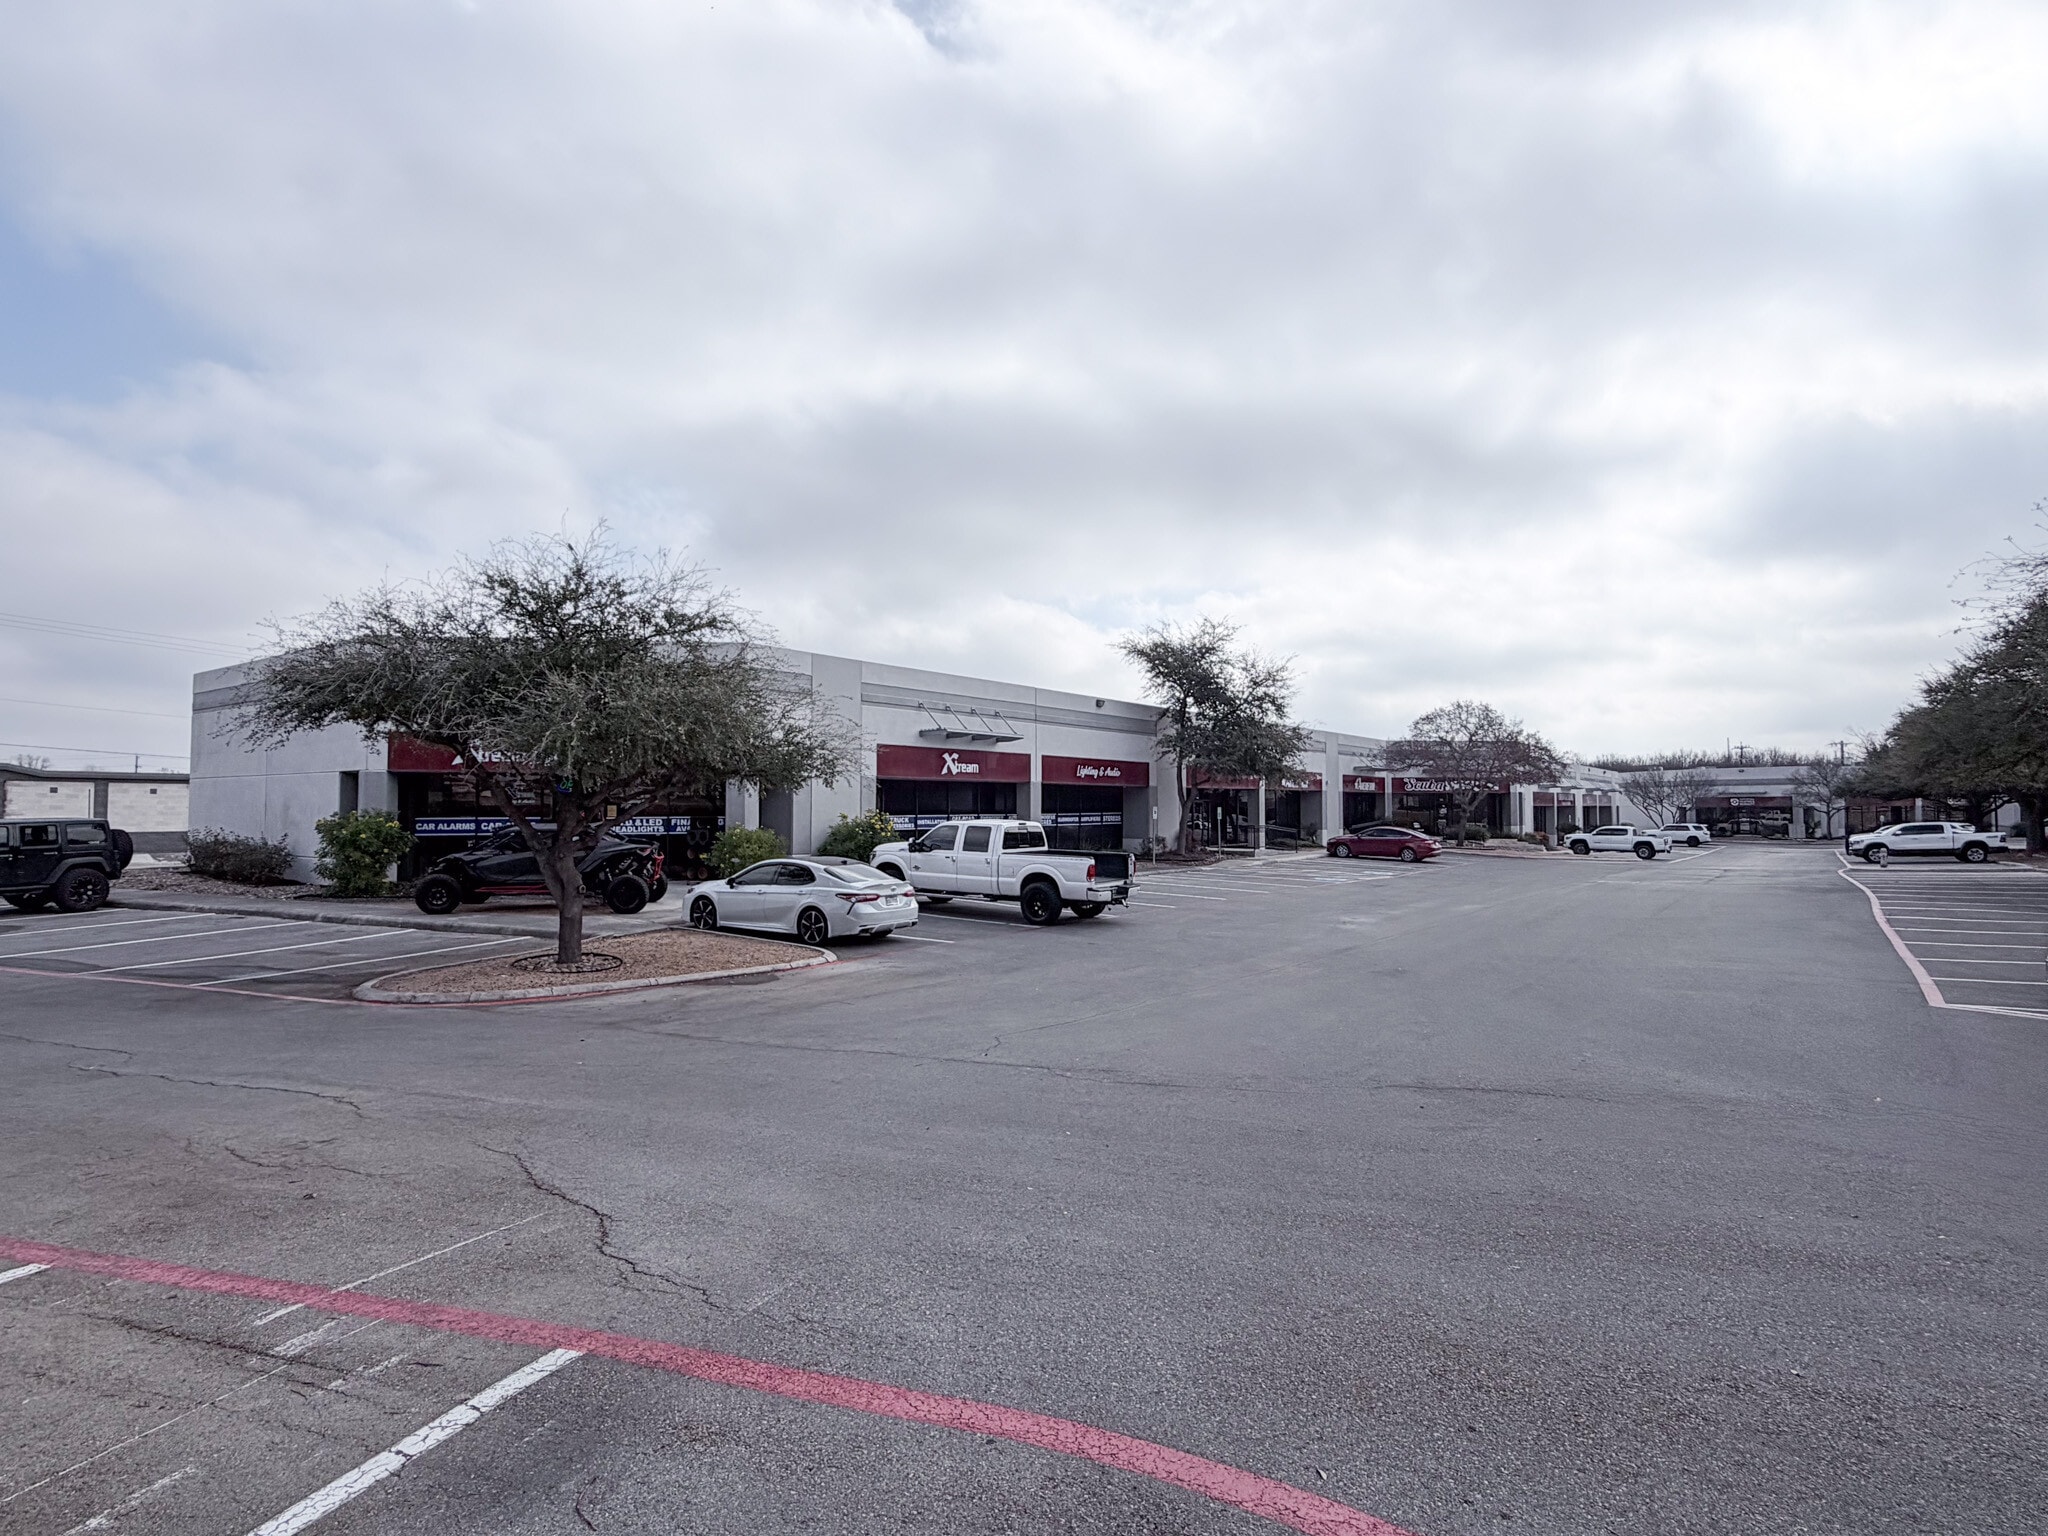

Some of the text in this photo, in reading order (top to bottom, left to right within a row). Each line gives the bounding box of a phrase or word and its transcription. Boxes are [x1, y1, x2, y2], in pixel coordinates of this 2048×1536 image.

[941, 752, 979, 775] Xtream
[1076, 764, 1122, 779] Lighting & Audio
[1403, 777, 1444, 792] Scuba
[415, 822, 476, 831] CAR ALARMS
[634, 818, 643, 826] &
[643, 818, 663, 826] LED
